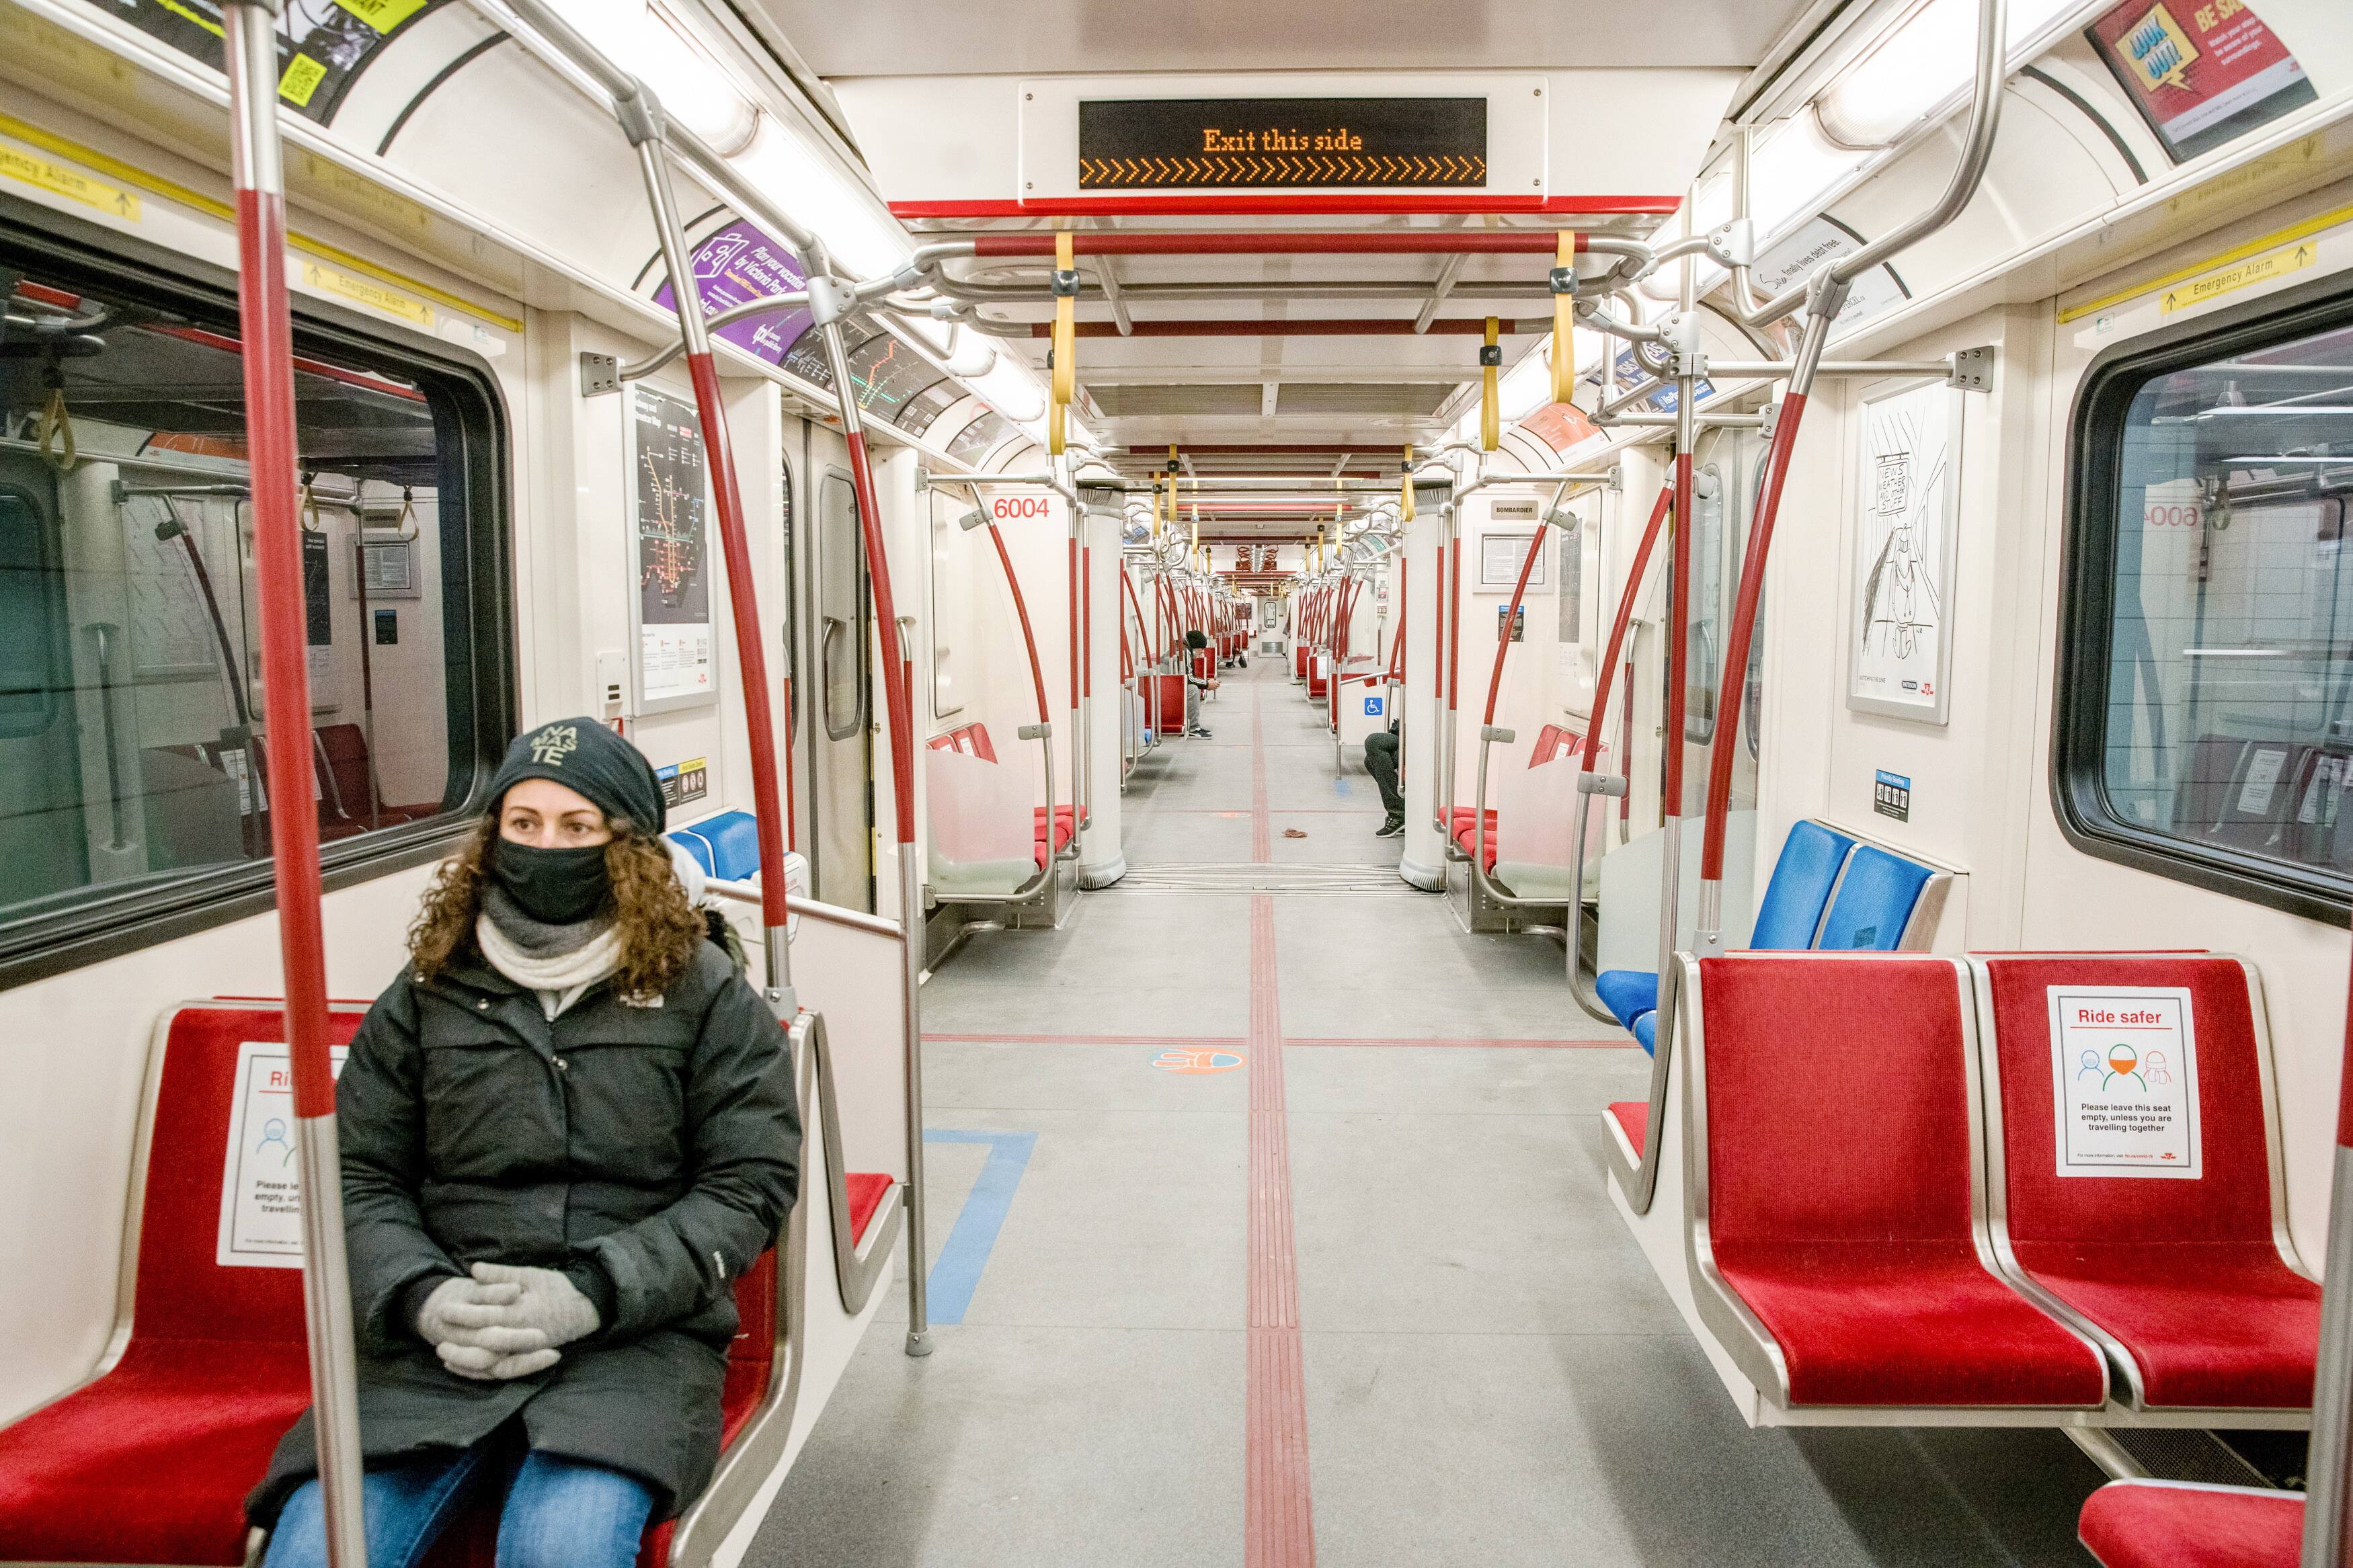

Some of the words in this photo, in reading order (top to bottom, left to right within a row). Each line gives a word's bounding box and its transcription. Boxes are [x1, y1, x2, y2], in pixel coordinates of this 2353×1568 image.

[2194, 3, 2219, 33] BE
[2127, 15, 2168, 60] LOOK
[2144, 39, 2183, 79] OUT!
[1203, 128, 1255, 151] Exit
[1262, 128, 1309, 151] this
[1314, 128, 1362, 151] side
[1782, 263, 1804, 277] finally
[1798, 255, 1815, 267] lives
[1810, 246, 1827, 259] debt
[1822, 239, 1841, 252] free.
[734, 255, 749, 270] by
[743, 259, 771, 286] Victoria
[751, 246, 770, 261] Plan
[766, 256, 782, 272] your
[779, 266, 806, 291] vacation
[2194, 271, 2242, 295] Emergency
[2245, 260, 2273, 277] Alarm
[339, 275, 383, 302] Emergency
[385, 289, 406, 308] Alarm
[1880, 464, 1904, 479] NEWS
[1878, 475, 1905, 491] WEATHER
[1880, 490, 1888, 501] AND
[1891, 485, 1905, 498] OTHER
[994, 498, 1049, 519] 6004
[1882, 496, 1903, 510] STUFF
[1903, 681, 1917, 690] PATTISON
[542, 726, 577, 740] NA
[532, 745, 568, 766] TE
[2079, 1009, 2115, 1023] Ride
[2120, 1010, 2162, 1024] safer
[270, 1071, 292, 1087] Ri
[2081, 1103, 2108, 1111] Please
[2135, 1104, 2151, 1112] this
[2081, 1114, 2108, 1122] empty,
[2140, 1115, 2156, 1123] you
[2089, 1124, 2126, 1132] travelling
[2129, 1124, 2165, 1133] together
[256, 1180, 287, 1190] Please
[262, 1205, 301, 1213] travellin
